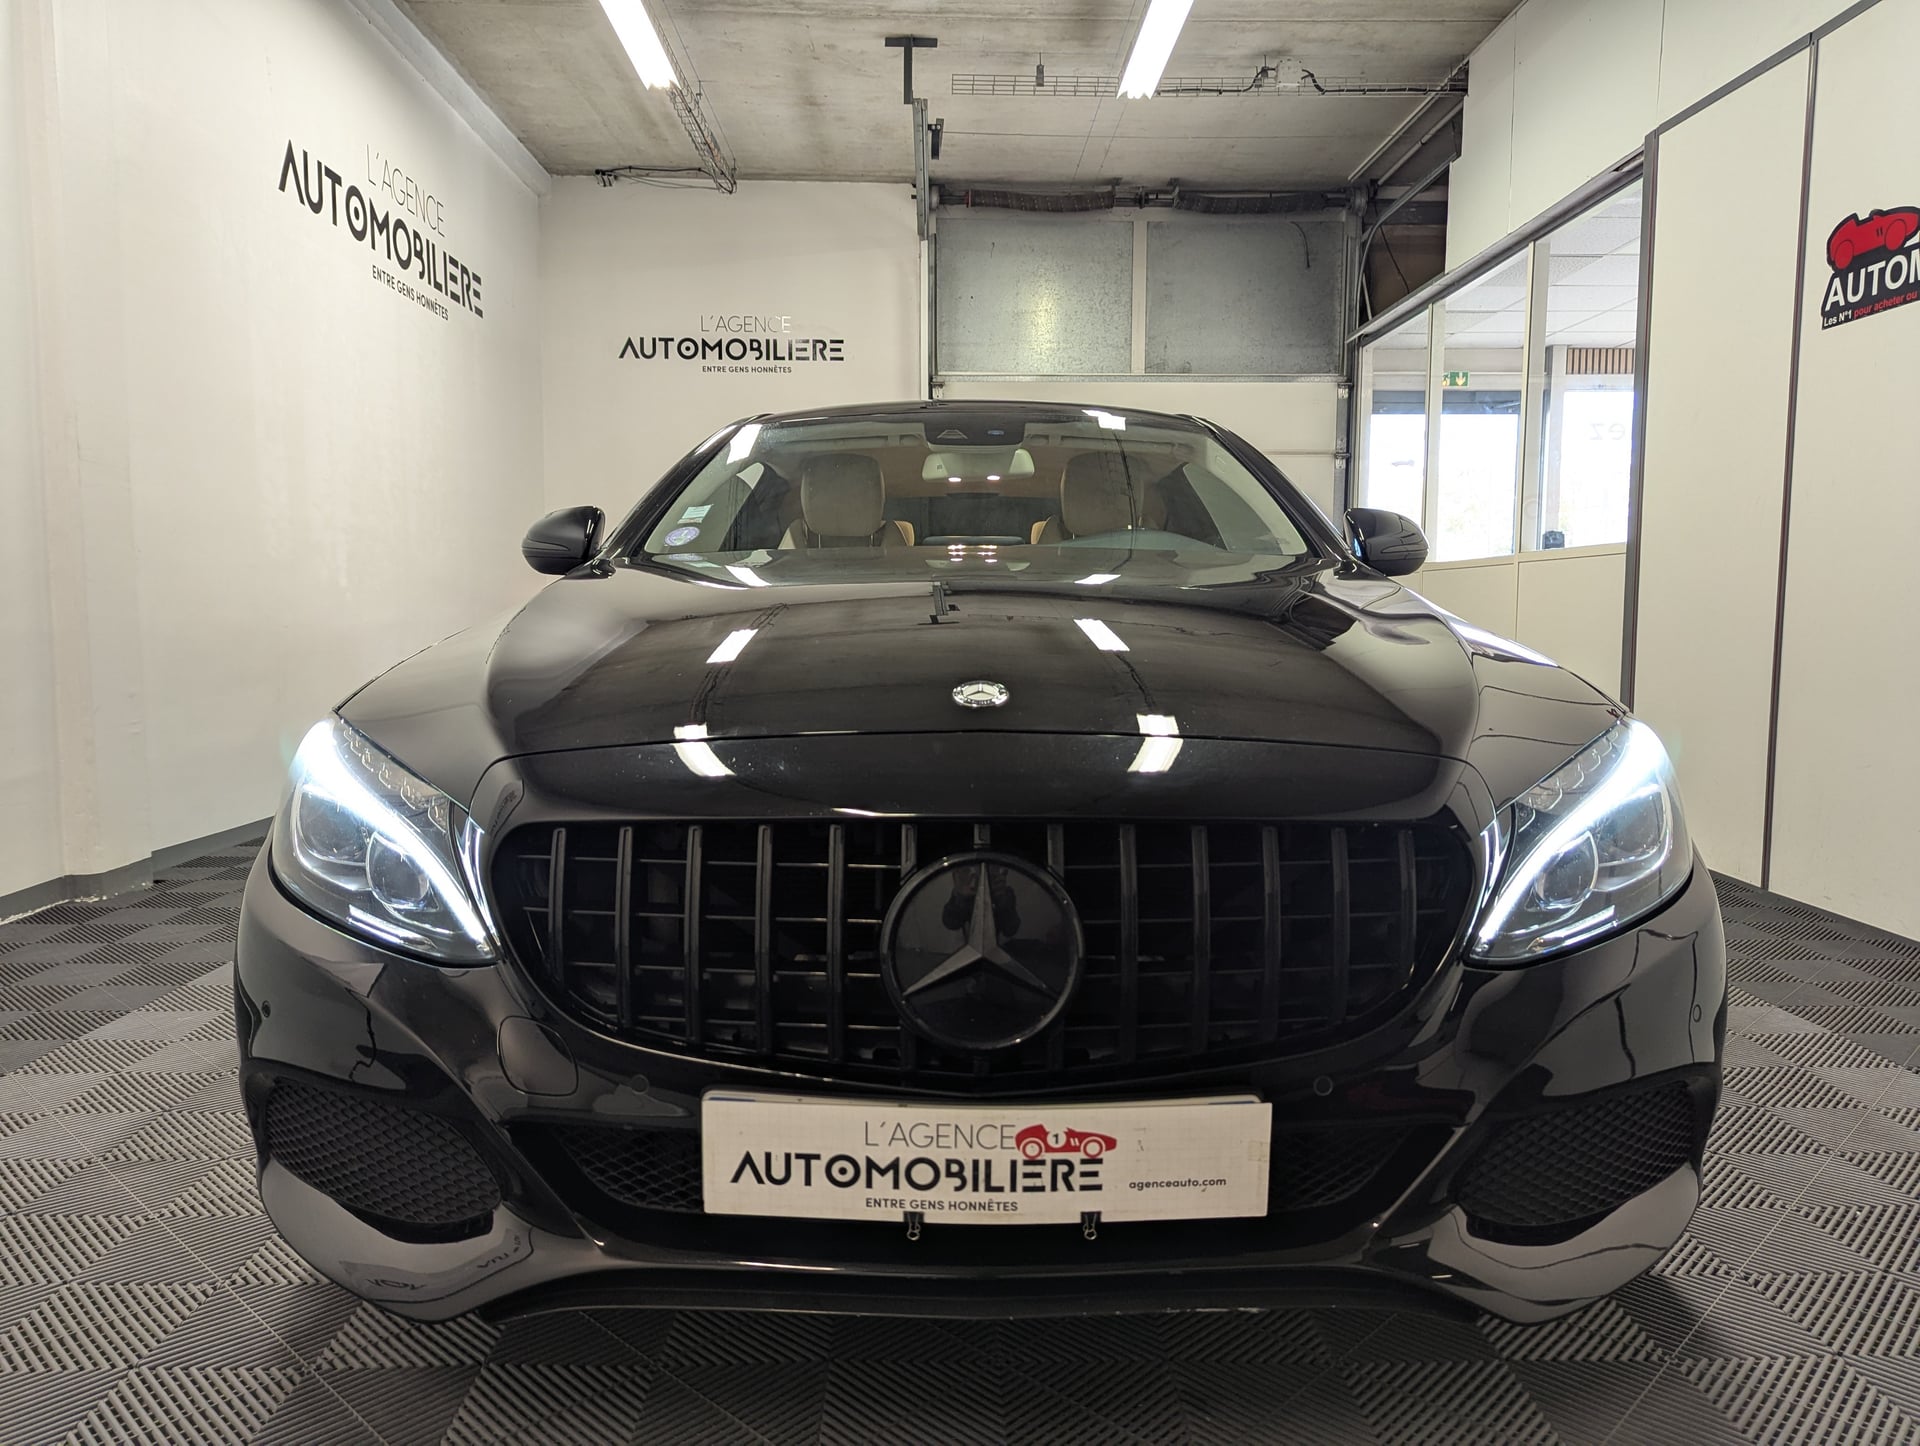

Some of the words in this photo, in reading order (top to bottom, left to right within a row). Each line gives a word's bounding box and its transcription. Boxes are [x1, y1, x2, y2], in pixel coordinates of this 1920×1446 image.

[367, 144, 445, 237] L'AGENCE
[278, 139, 483, 319] AUTOMOBILIERE
[372, 265, 396, 290] ENTRE
[396, 280, 415, 301] GENS
[1853, 304, 1873, 319] pour
[1874, 294, 1905, 311] acheter
[1906, 291, 1918, 301] ou
[700, 315, 792, 333] L'AGENCE
[618, 337, 844, 361] AUTOMOBILIERE
[728, 366, 749, 374] GENS
[865, 1121, 1016, 1150] L'AGENCE
[1052, 1133, 1059, 1145] 1
[730, 1151, 1103, 1193] AUTOMOBILIERE
[1129, 1177, 1227, 1191] agenceauto.com
[865, 1198, 906, 1209] ENTRE
[909, 1199, 945, 1211] GENS
